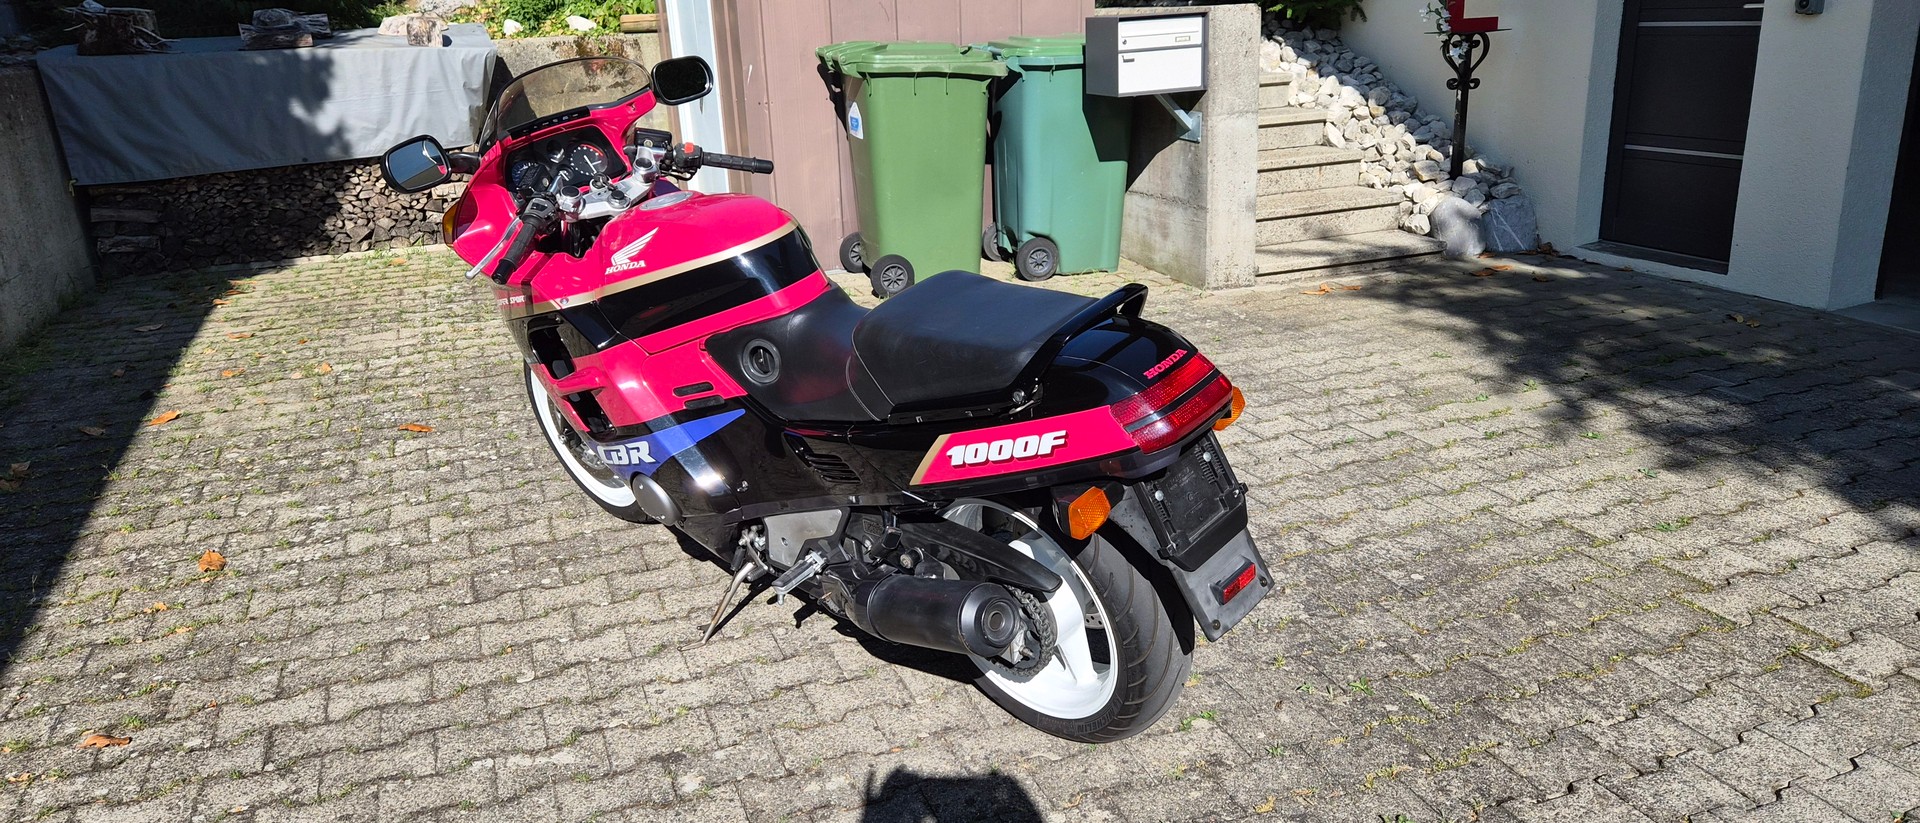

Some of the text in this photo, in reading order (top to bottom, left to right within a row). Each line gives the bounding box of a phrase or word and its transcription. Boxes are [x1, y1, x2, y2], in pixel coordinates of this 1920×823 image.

[605, 260, 646, 275] HONDA
[1143, 349, 1188, 379] HONDA
[597, 441, 656, 465] CBR
[946, 430, 1067, 467] 1000F
